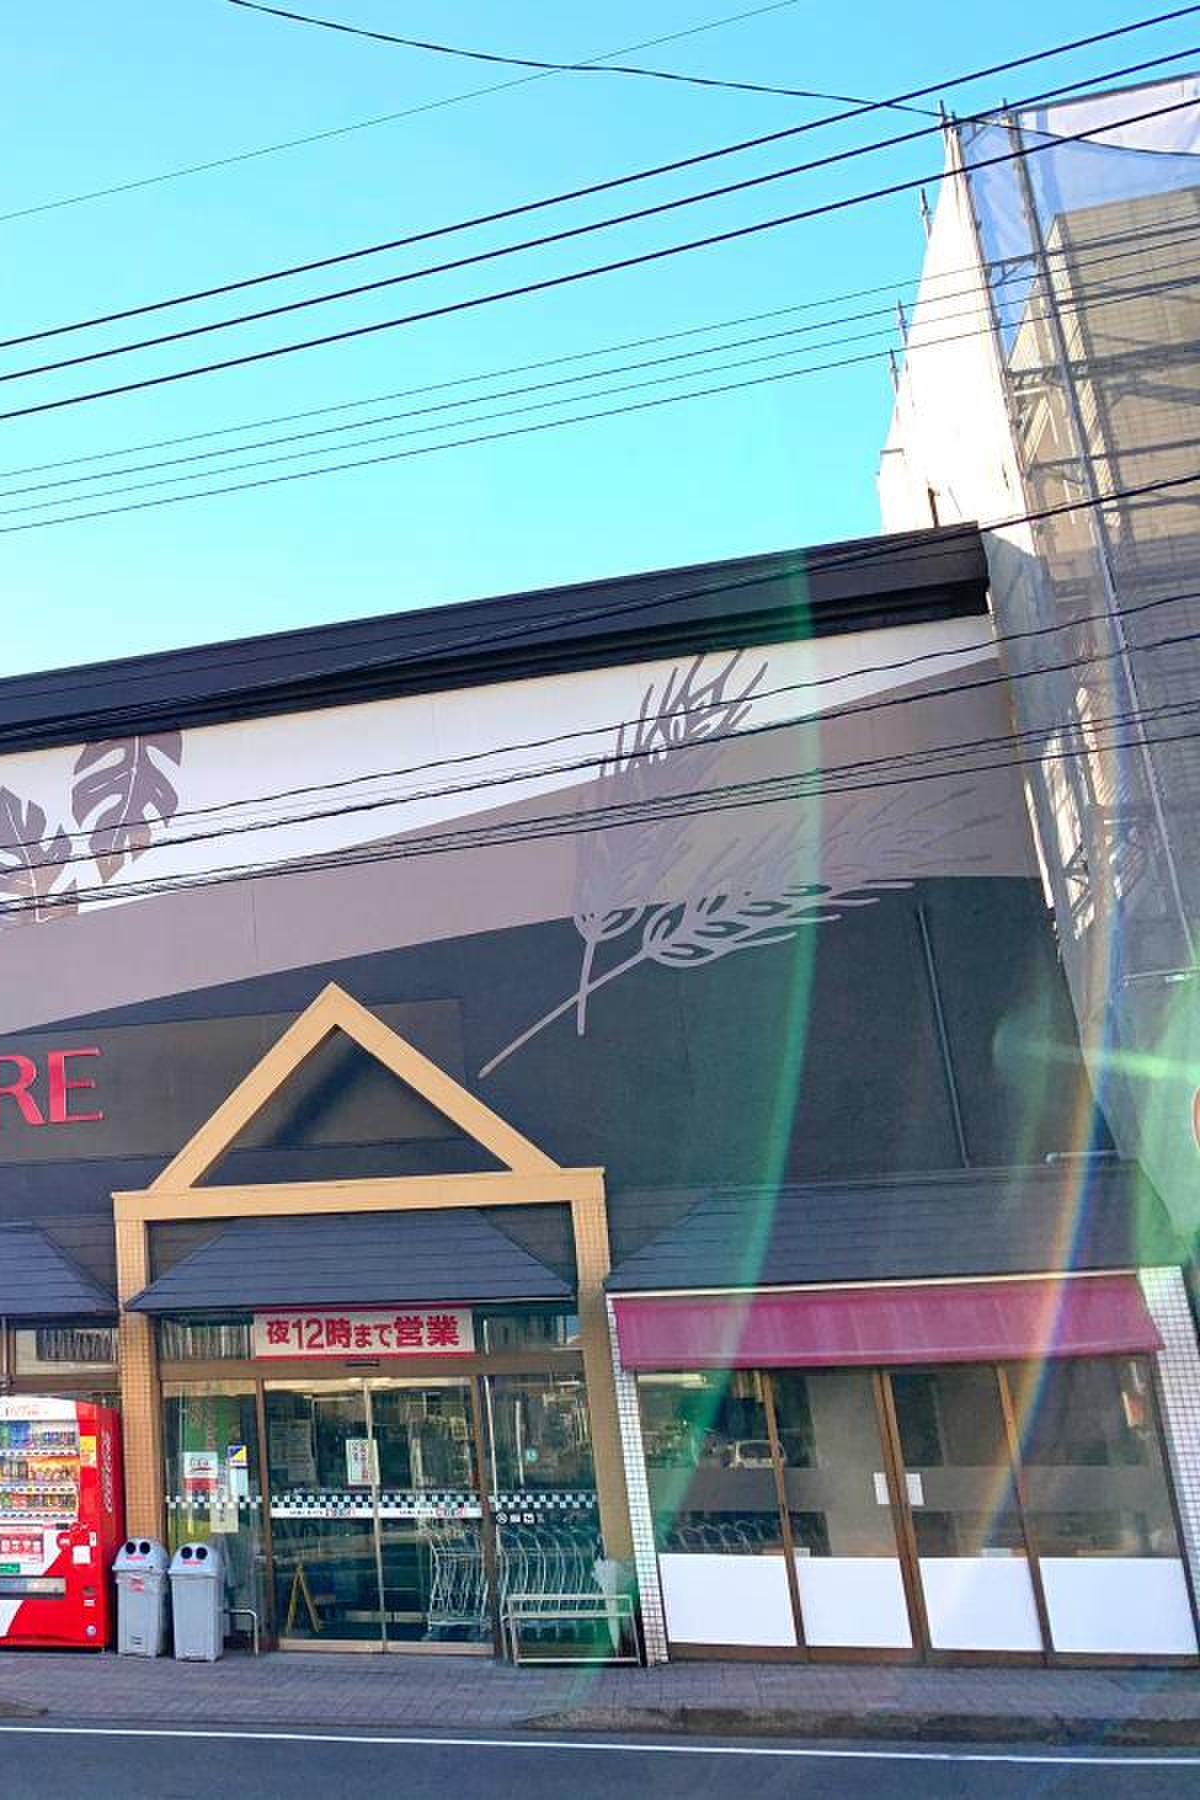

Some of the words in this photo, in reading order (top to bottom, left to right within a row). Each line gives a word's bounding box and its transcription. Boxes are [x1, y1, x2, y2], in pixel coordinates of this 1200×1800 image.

[266, 1315, 460, 1350] 夜12時まで営業
